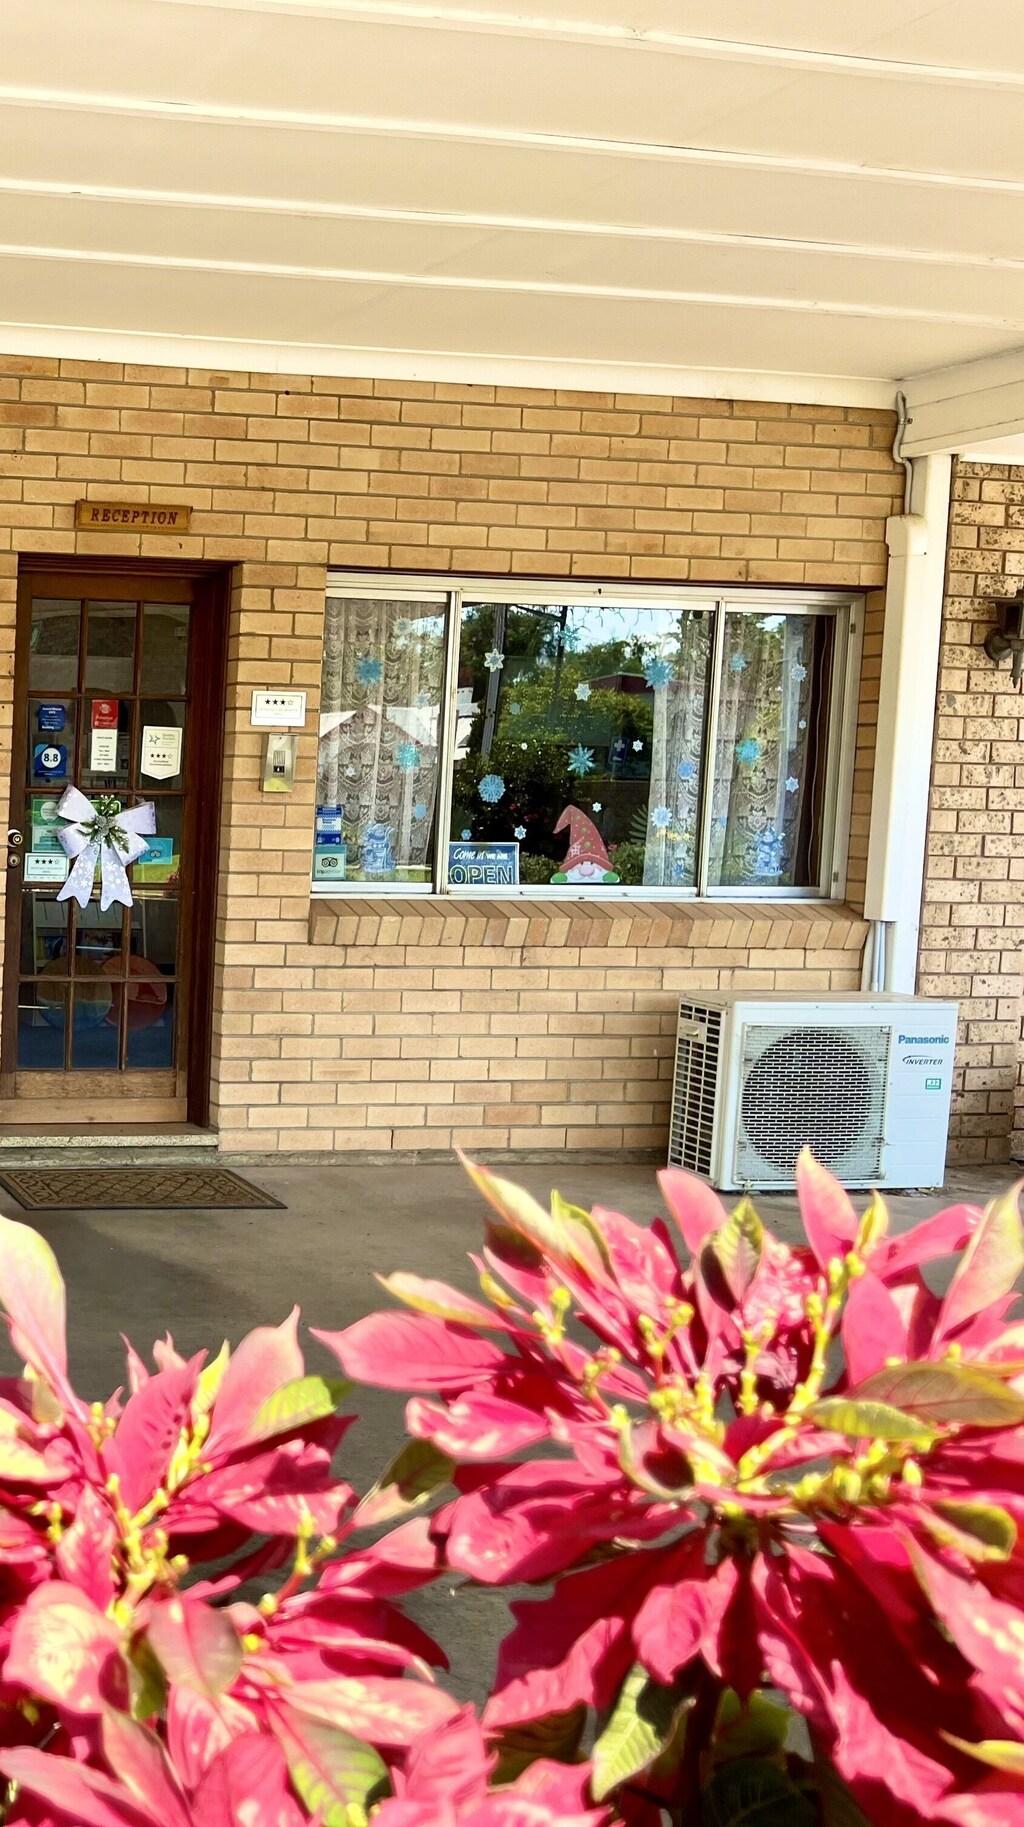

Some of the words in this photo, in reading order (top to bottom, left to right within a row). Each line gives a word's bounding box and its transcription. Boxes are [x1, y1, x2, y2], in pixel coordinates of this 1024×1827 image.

[91, 507, 179, 525] RECEPTION
[43, 753, 59, 762] 8.8
[449, 864, 514, 884] OPEN
[897, 1034, 950, 1044] Panasonic
